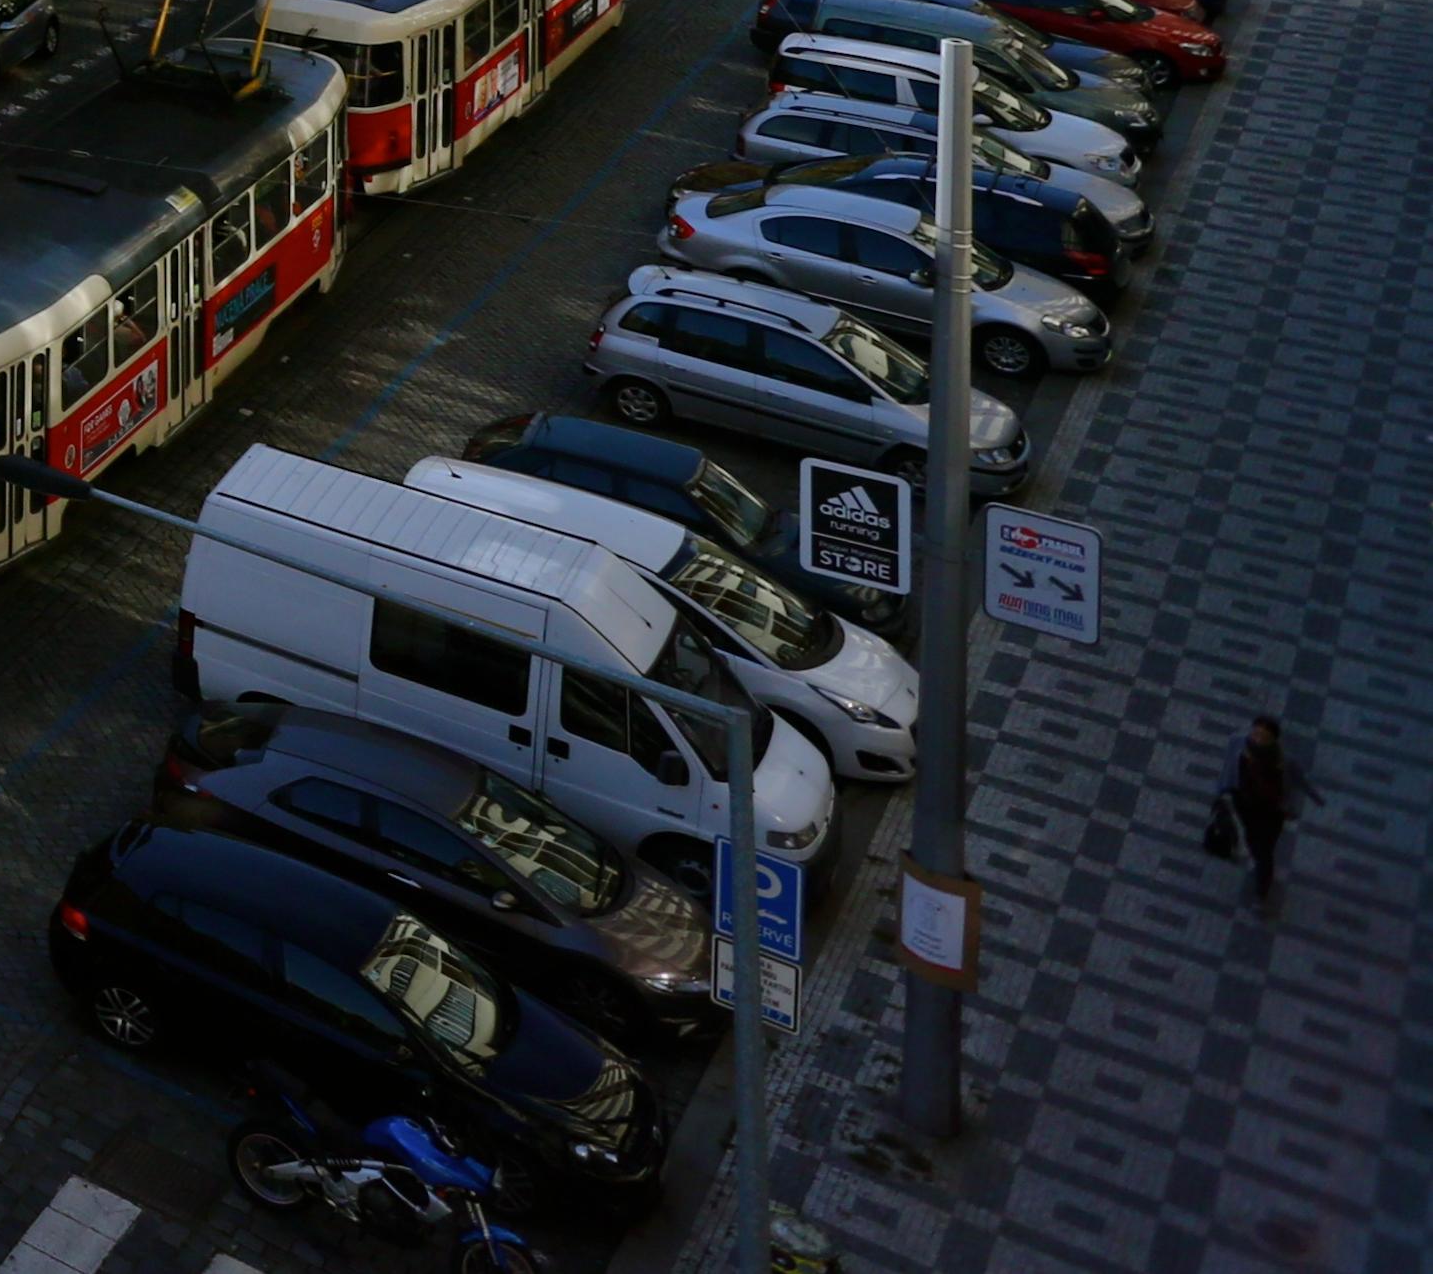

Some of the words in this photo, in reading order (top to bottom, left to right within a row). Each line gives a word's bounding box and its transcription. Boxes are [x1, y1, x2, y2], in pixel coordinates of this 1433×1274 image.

[819, 502, 892, 530] adidas
[829, 519, 881, 541] running
[819, 549, 892, 581] STORE
[721, 912, 795, 949] RERVÉ
